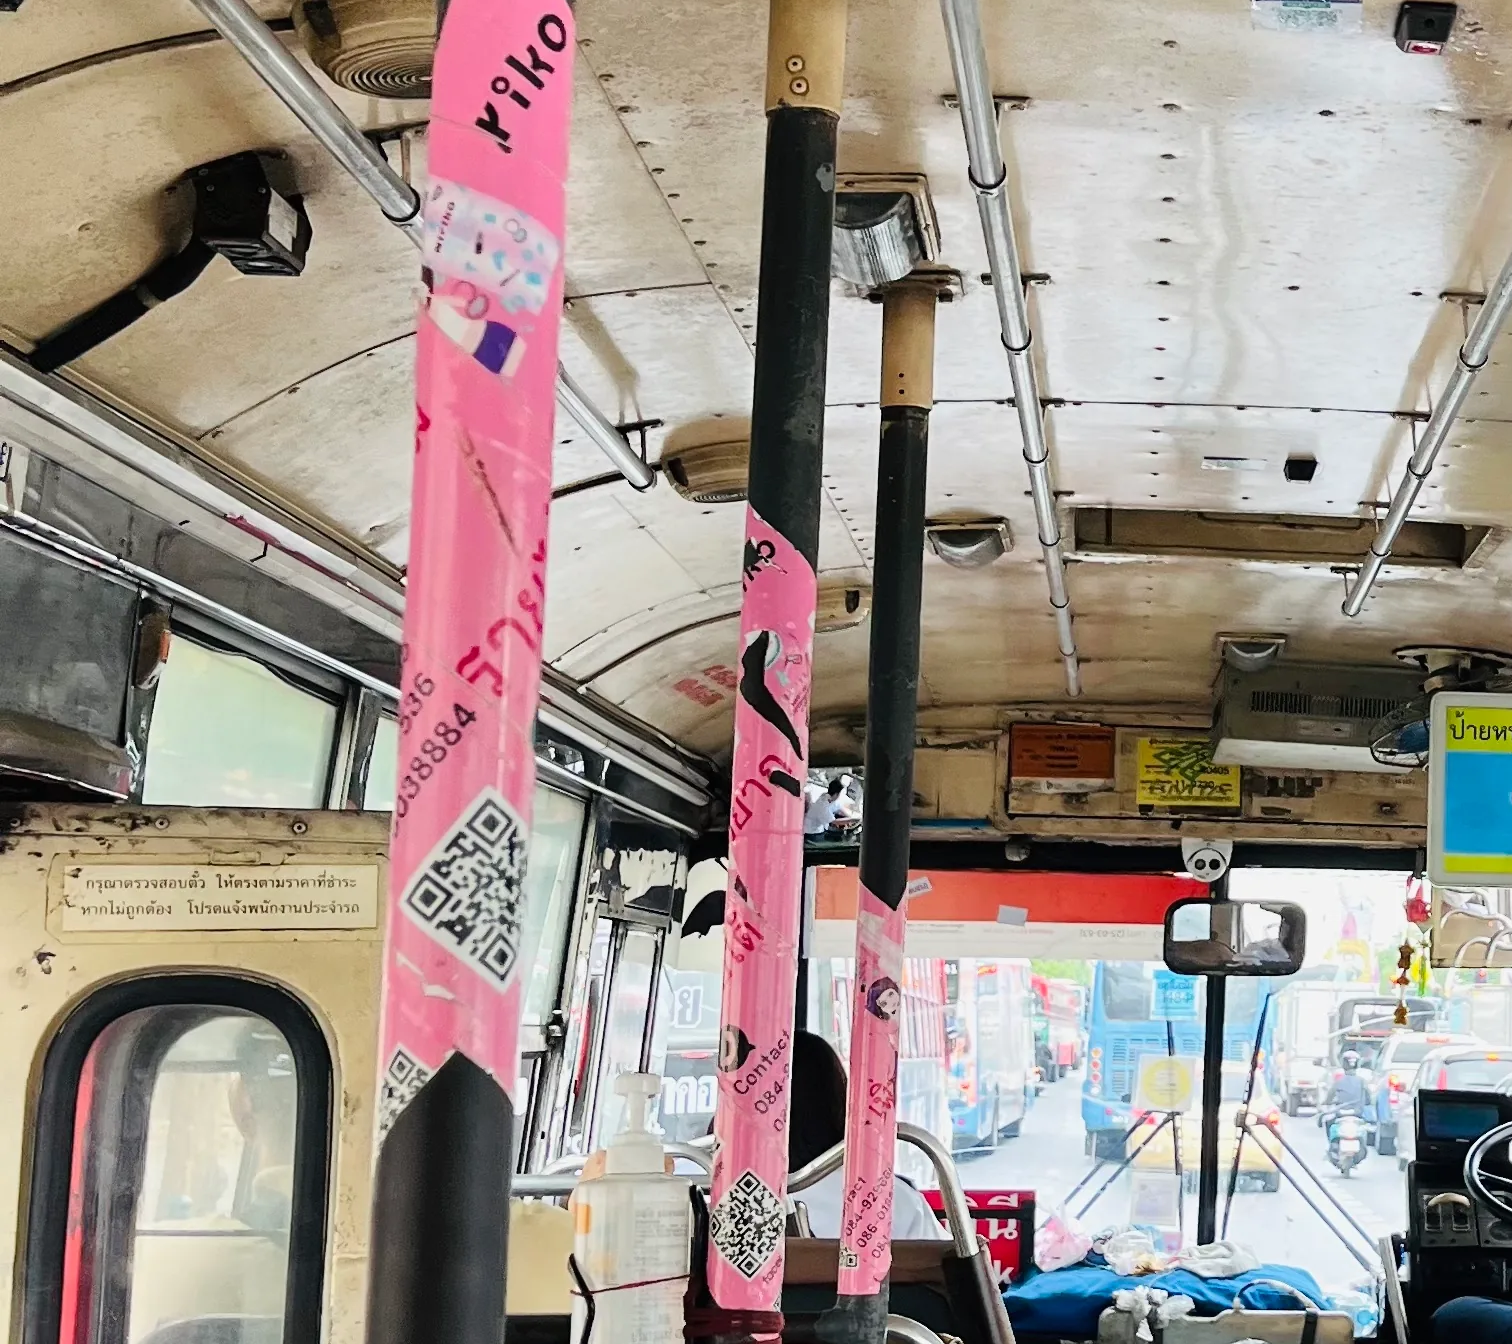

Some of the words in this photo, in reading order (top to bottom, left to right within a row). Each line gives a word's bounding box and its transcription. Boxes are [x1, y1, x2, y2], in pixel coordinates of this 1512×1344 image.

[85, 869, 206, 894] กรุณาตรวจสอบตั๋ว
[216, 869, 358, 891] ให้ตรงตามราคาที่ชำระ
[80, 898, 172, 921] หากไม่ถูกต้อง
[187, 898, 360, 917] โปรดแจ้งพนักงานประจำรถ
[733, 1029, 790, 1095] Contact
